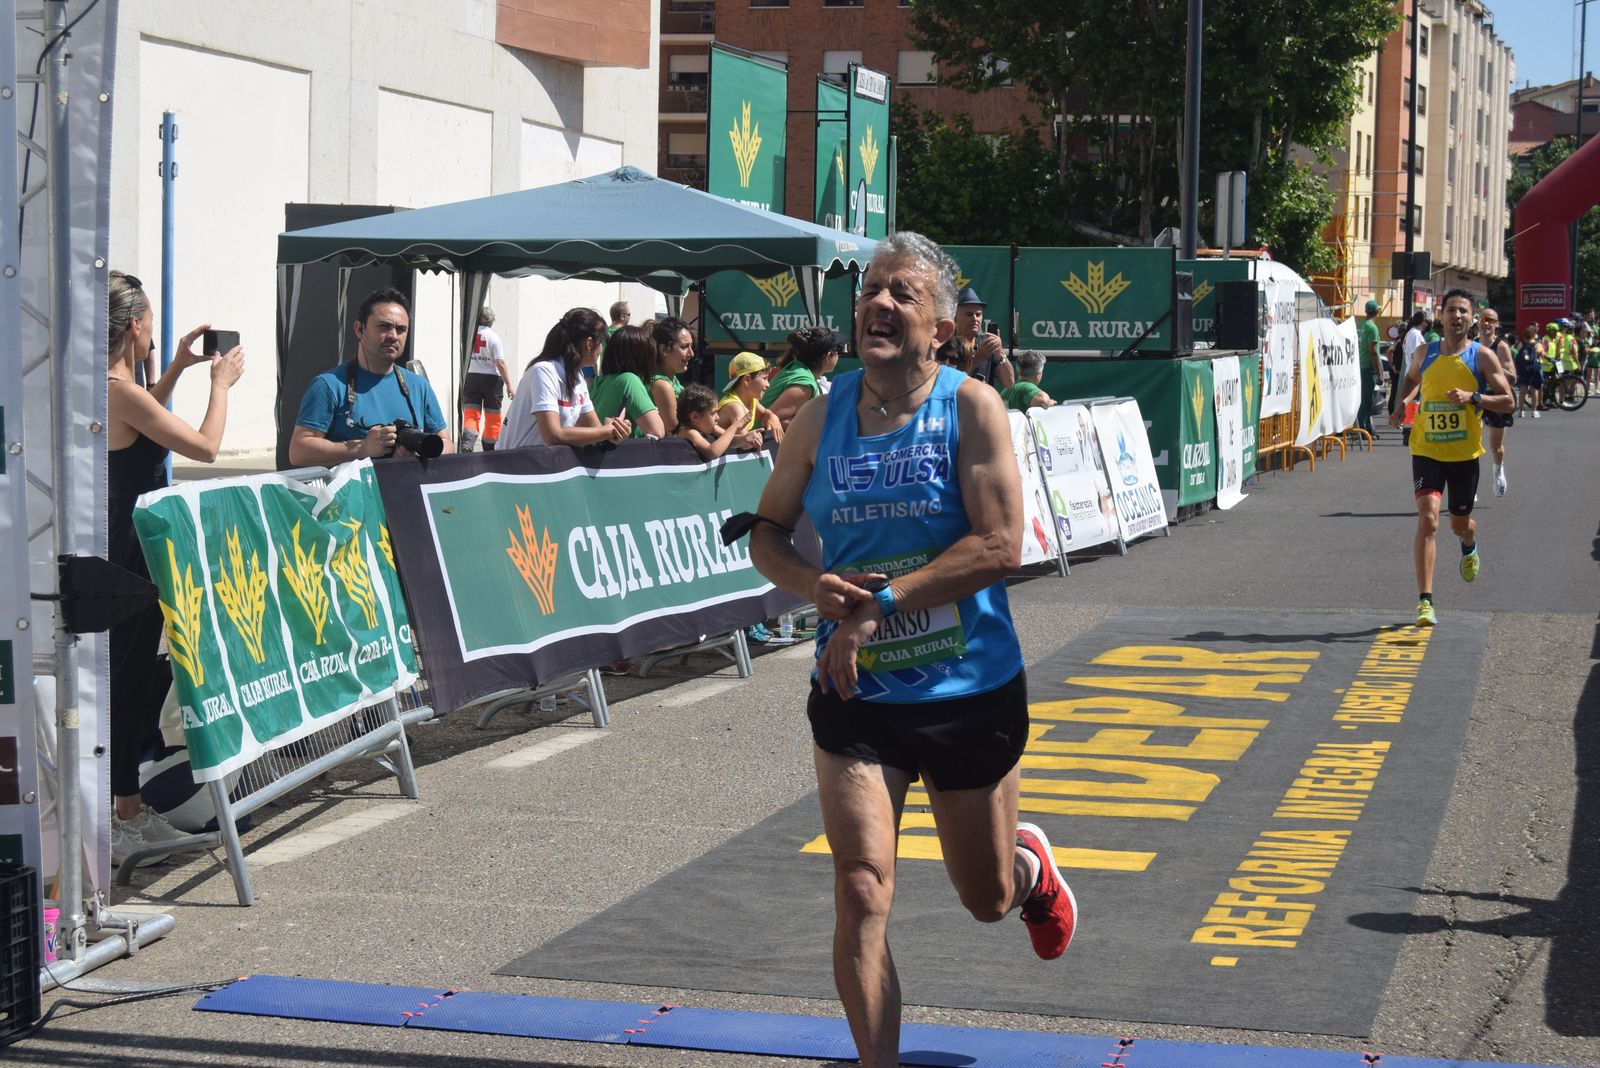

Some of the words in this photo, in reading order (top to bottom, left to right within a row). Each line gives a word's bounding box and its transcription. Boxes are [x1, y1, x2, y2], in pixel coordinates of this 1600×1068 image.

[720, 312, 766, 331] CAJA
[771, 313, 840, 332] RURAL
[1031, 320, 1083, 339] CAJA
[1088, 320, 1160, 338] RURAL
[1428, 413, 1460, 430] 139
[884, 443, 949, 464] COMERCIAL
[883, 456, 951, 489] ULSA
[832, 498, 942, 524] ATLETISMO
[1116, 482, 1161, 522] OCEANIC
[568, 523, 653, 600] CAJA
[645, 508, 753, 586] RURAL
[862, 554, 928, 573] FUNDACION
[880, 648, 912, 663] CAJA
[913, 637, 958, 657] RURAL
[1190, 829, 1352, 948] REFORMA
[1272, 740, 1391, 821] INTEGRAL
[1332, 681, 1414, 723] DISEÑO
